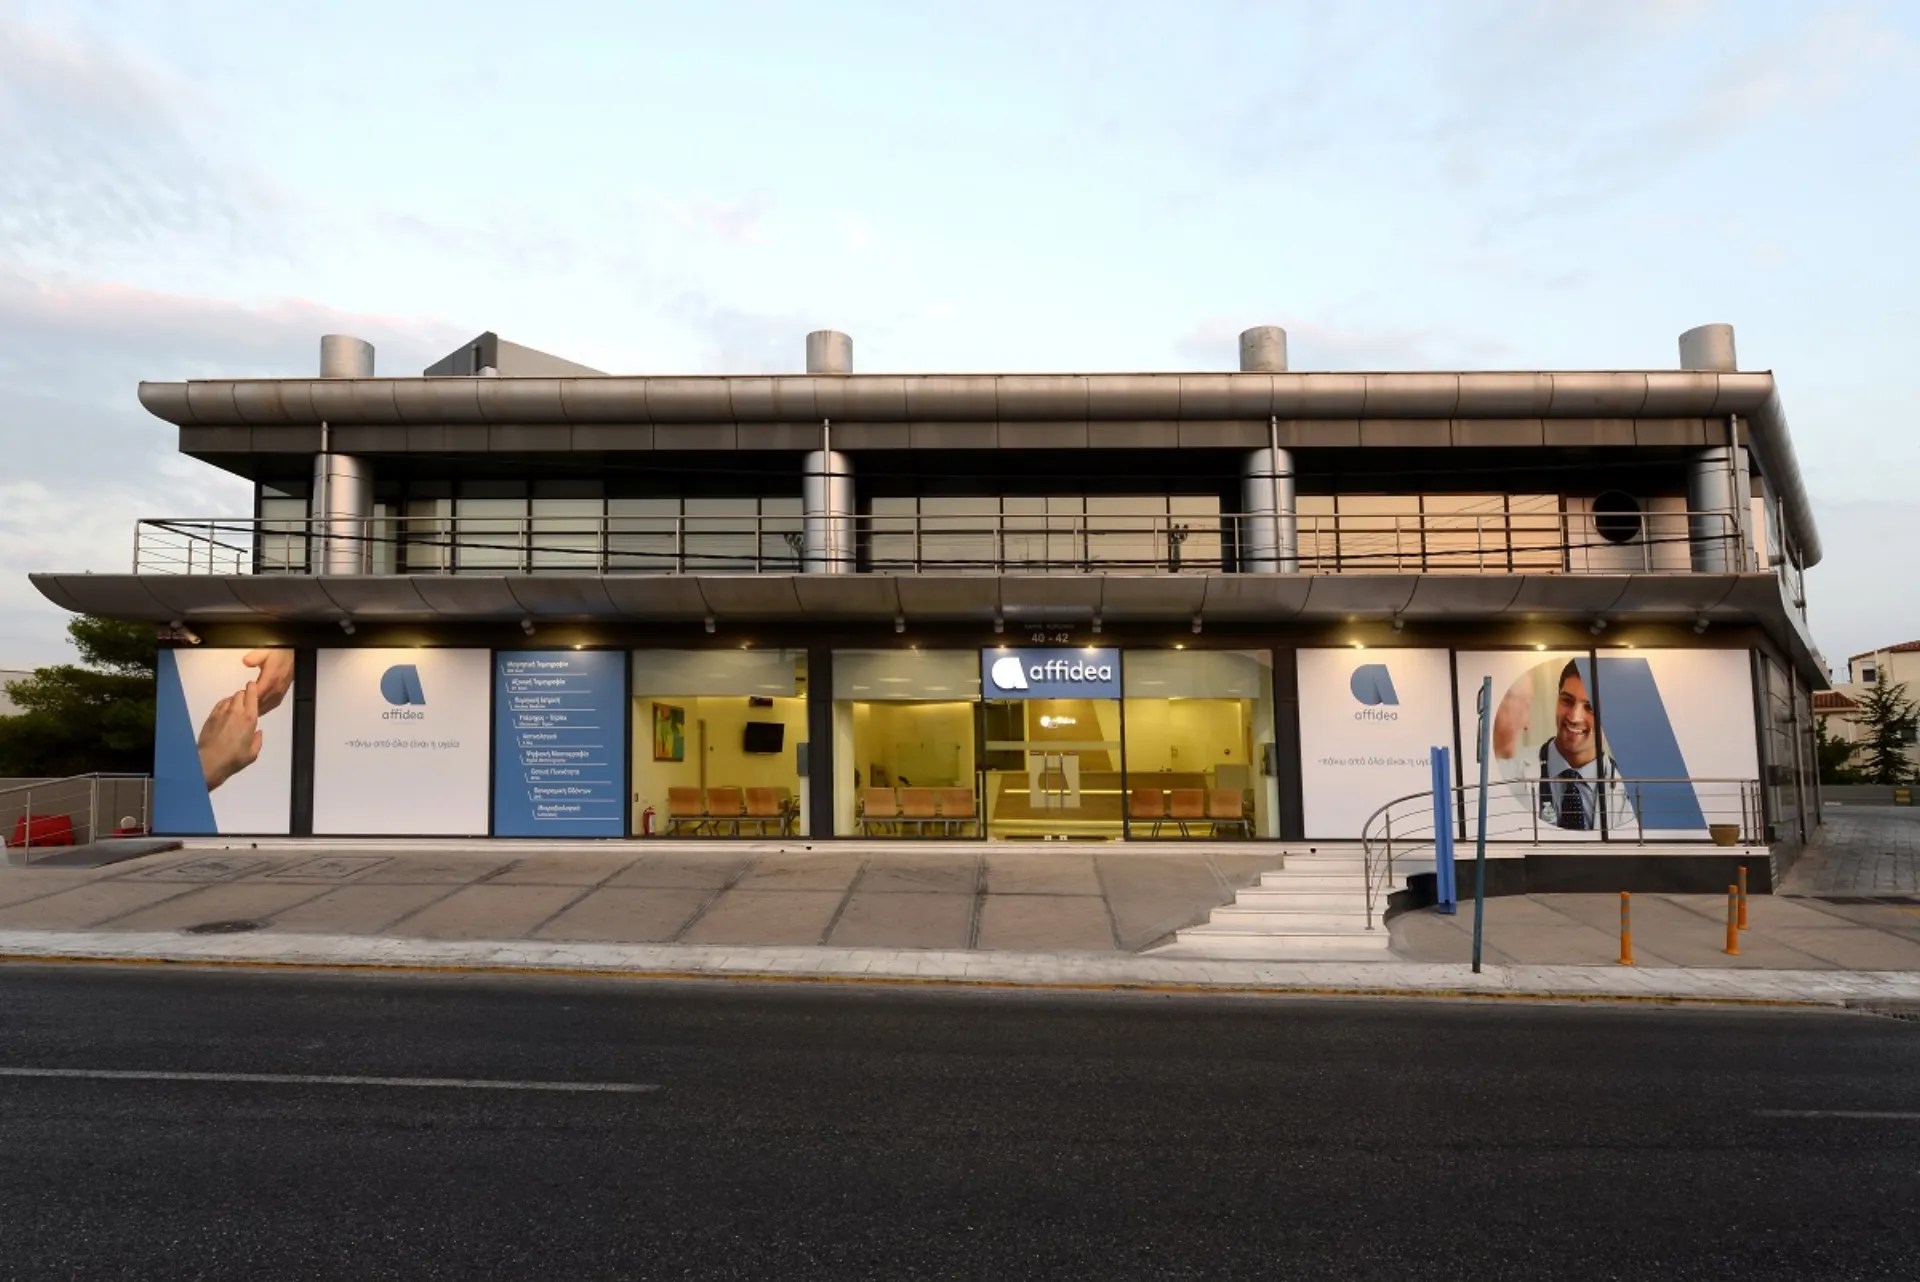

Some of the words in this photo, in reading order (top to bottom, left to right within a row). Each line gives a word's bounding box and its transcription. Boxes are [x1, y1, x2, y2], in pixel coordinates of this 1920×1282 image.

[1031, 633, 1045, 643] 40
[1055, 633, 1069, 643] 42
[1029, 659, 1112, 681] affidea
[382, 708, 424, 720] affidea
[1354, 708, 1398, 721] affidea
